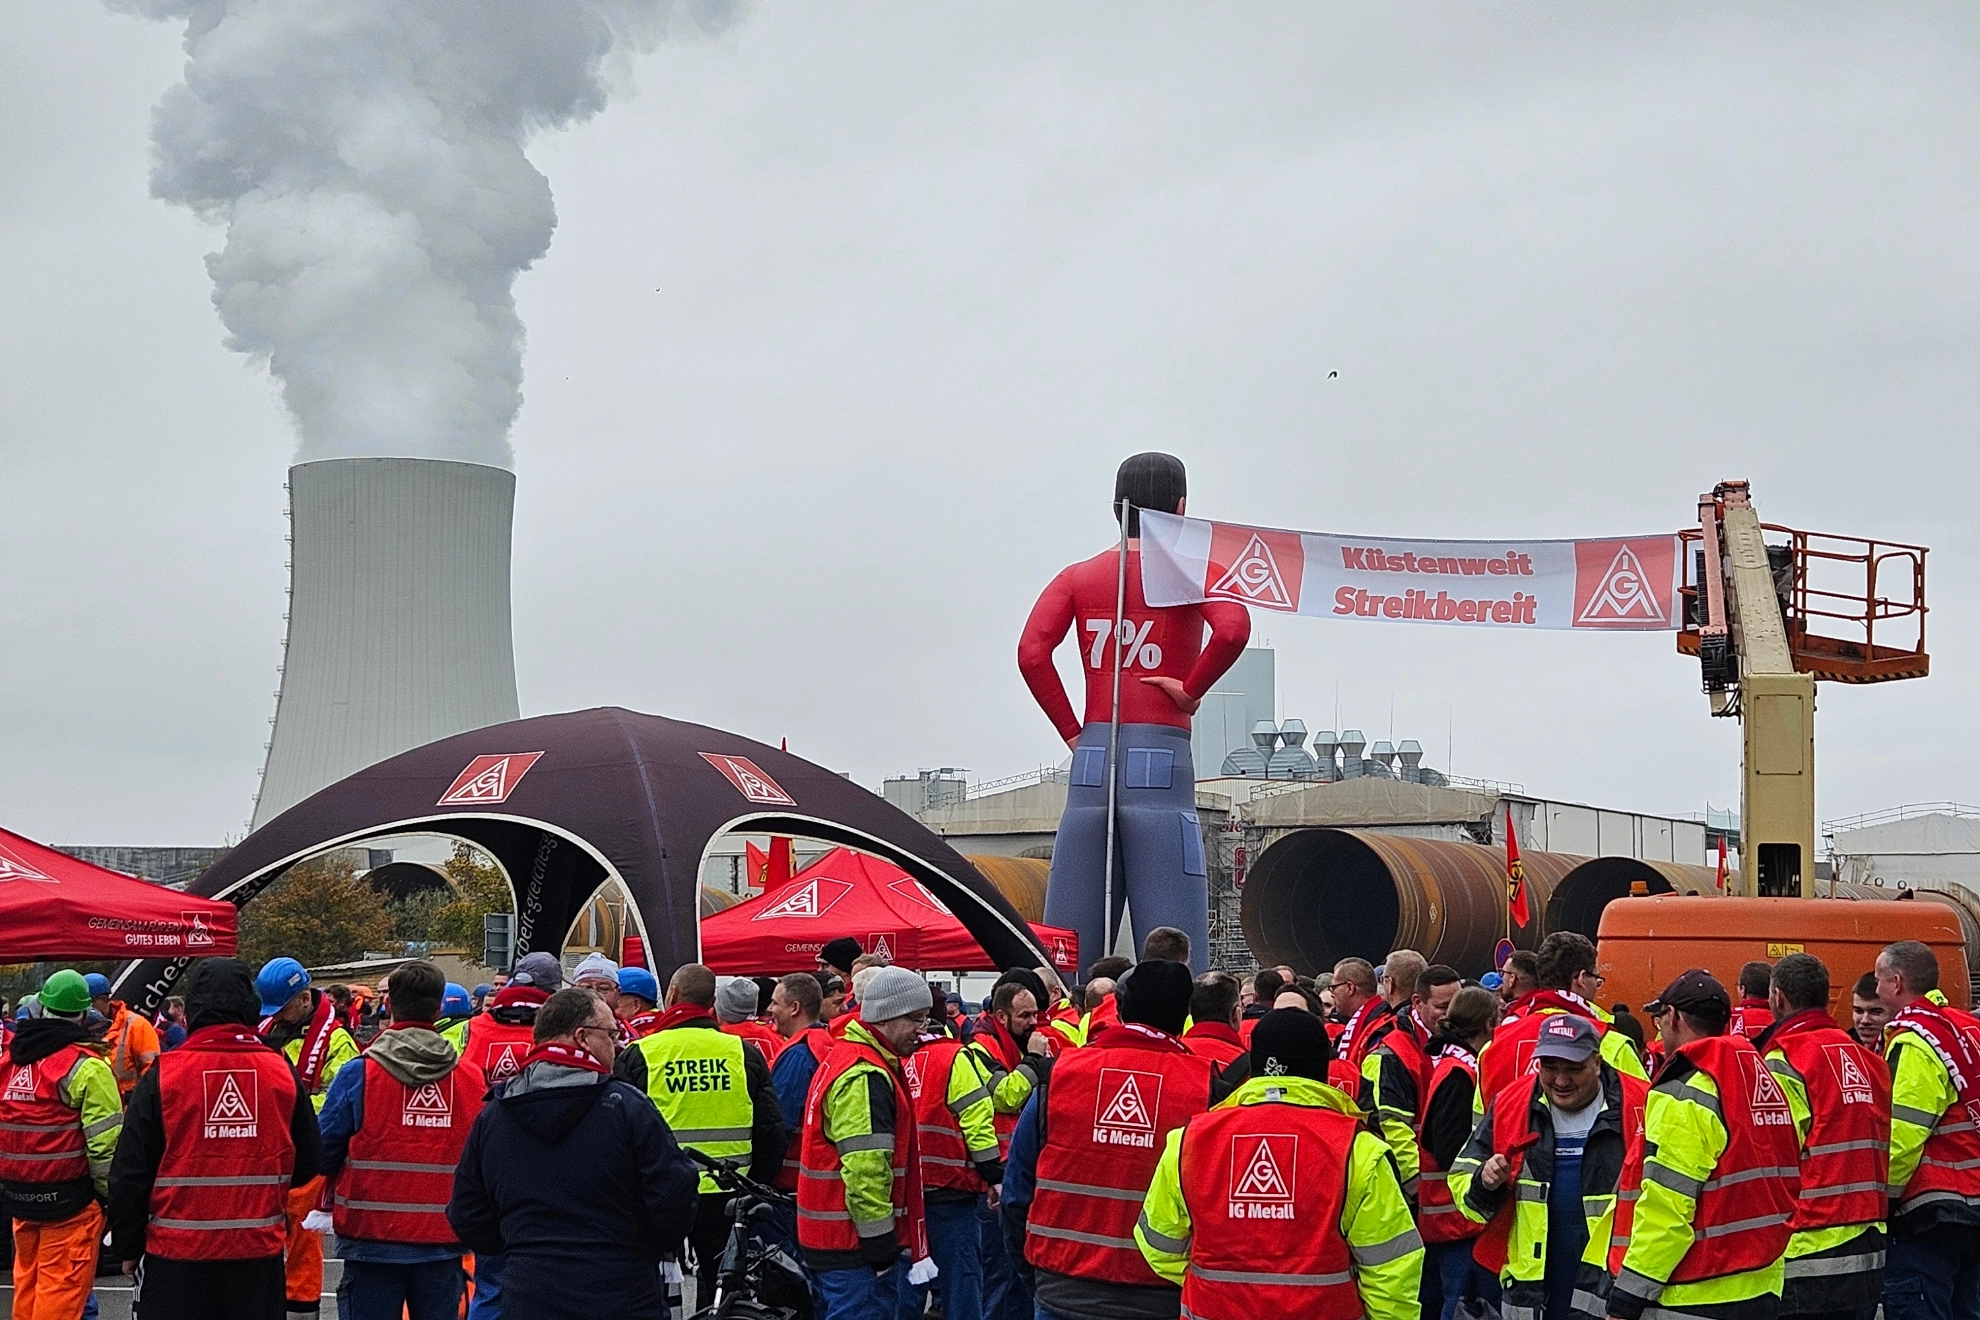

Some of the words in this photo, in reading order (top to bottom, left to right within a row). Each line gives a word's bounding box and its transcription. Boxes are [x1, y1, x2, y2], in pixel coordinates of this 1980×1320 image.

[1341, 546, 1534, 576] Küstenweit
[1332, 586, 1538, 625] Streikbereit
[1085, 618, 1163, 670] 7%
[88, 917, 146, 931] GEMEINSAM
[125, 933, 153, 945] GUTES
[154, 934, 181, 946] LEBEN
[665, 1058, 728, 1077] STREIK
[666, 1074, 731, 1094] WESTE
[406, 1081, 449, 1112] GM
[1842, 1092, 1853, 1104] IG
[402, 1114, 414, 1126] IG
[415, 1115, 451, 1128] Metall
[1751, 1112, 1764, 1126] IG
[1764, 1111, 1792, 1126] etall
[204, 1125, 216, 1138] IG
[218, 1125, 258, 1138] Metall
[1093, 1128, 1107, 1143] IG
[1109, 1130, 1154, 1148] Metall
[1229, 1203, 1245, 1218] IG
[1248, 1203, 1295, 1220] Metall
